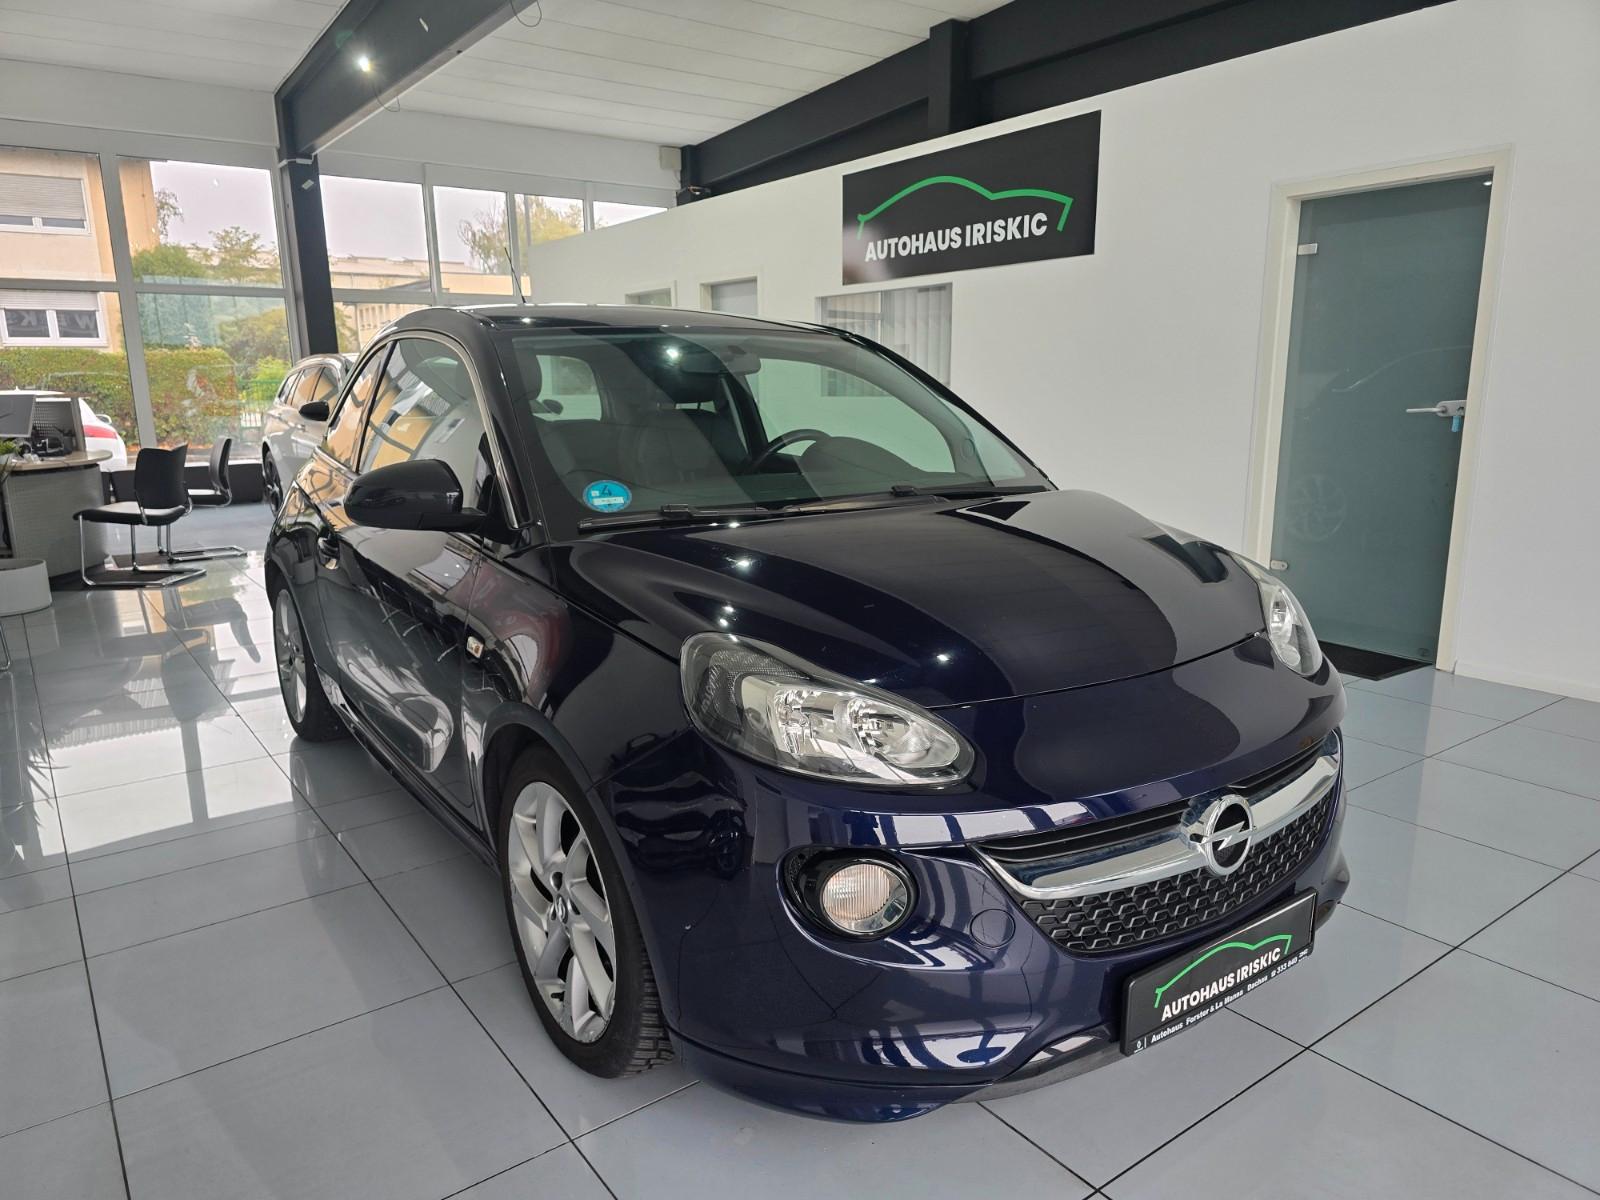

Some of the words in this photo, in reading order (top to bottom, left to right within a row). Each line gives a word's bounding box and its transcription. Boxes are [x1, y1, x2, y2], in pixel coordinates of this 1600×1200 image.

[865, 227, 962, 262] AUTOHAUS
[965, 212, 1048, 247] IRISKIC
[1151, 1022, 1184, 1043] Autohaus
[1186, 1008, 1210, 1025] Forster
[1247, 975, 1268, 991] Dachau
[1161, 972, 1235, 1021] AUTOHAUS
[1236, 947, 1281, 983] IRISKIC
